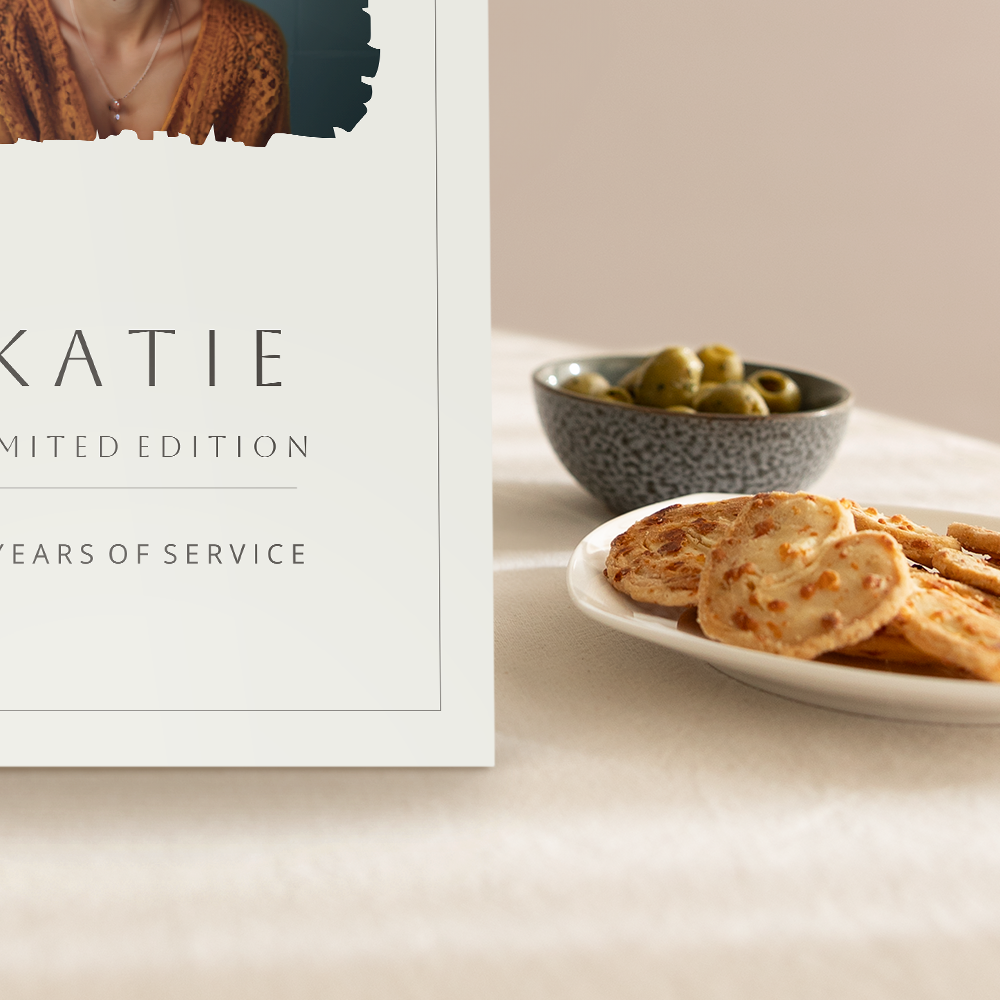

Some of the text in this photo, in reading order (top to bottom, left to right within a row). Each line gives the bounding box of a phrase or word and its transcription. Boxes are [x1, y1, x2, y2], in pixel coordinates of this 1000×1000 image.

[139, 435, 308, 458] EDITION
[108, 543, 150, 565] OF
[163, 543, 305, 565] SERVICE
